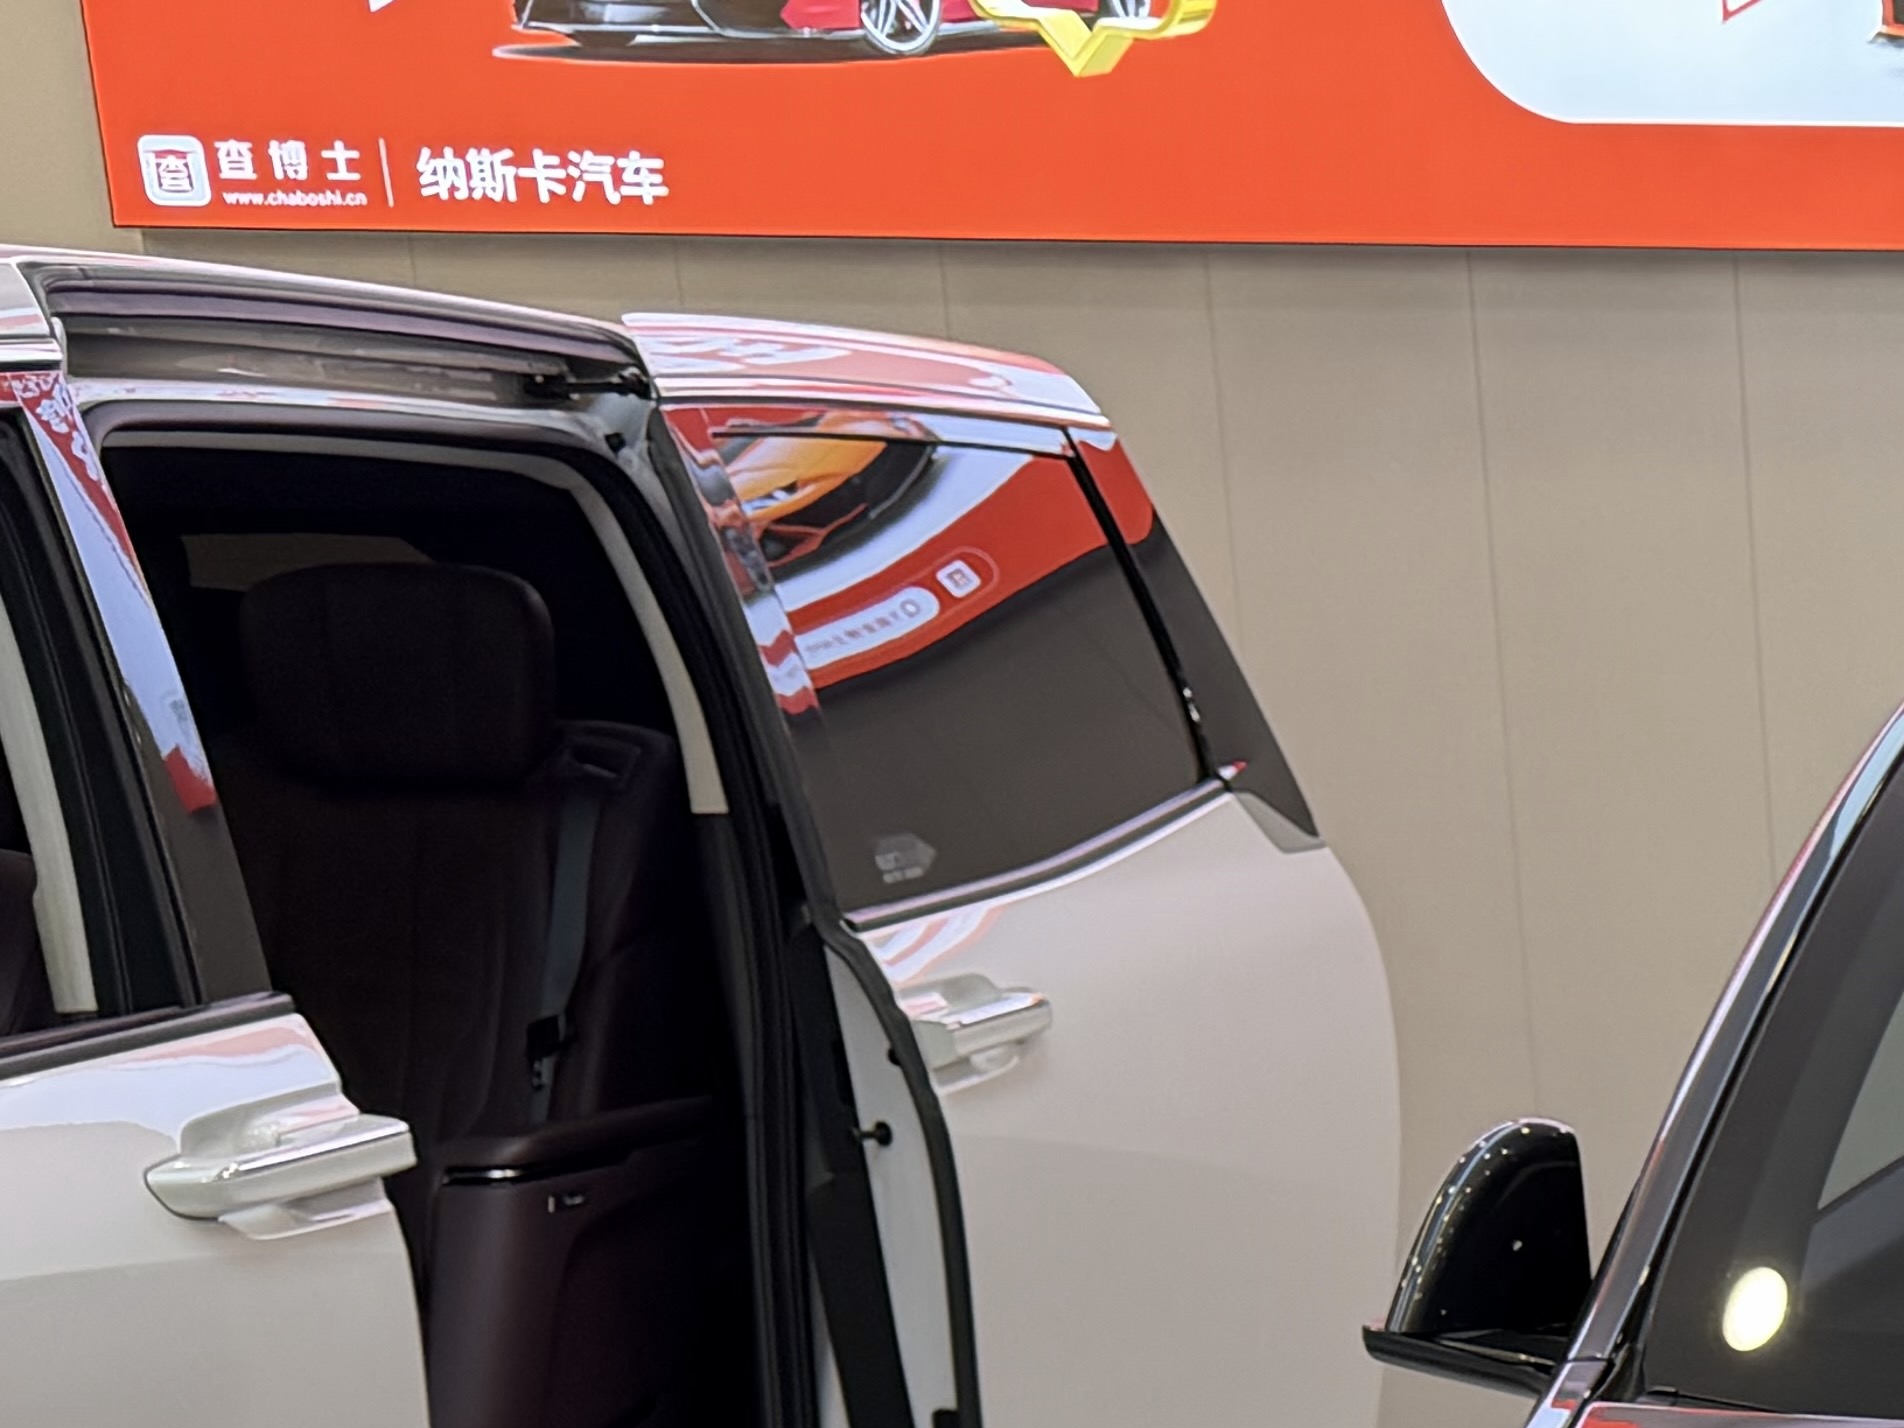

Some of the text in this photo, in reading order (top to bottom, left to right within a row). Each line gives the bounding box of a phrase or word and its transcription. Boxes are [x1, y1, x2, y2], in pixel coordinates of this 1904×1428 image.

[214, 139, 362, 180] 查博士
[416, 146, 670, 205] 纳斯卡汽车
[223, 190, 368, 206] www.chaboshi.cn
